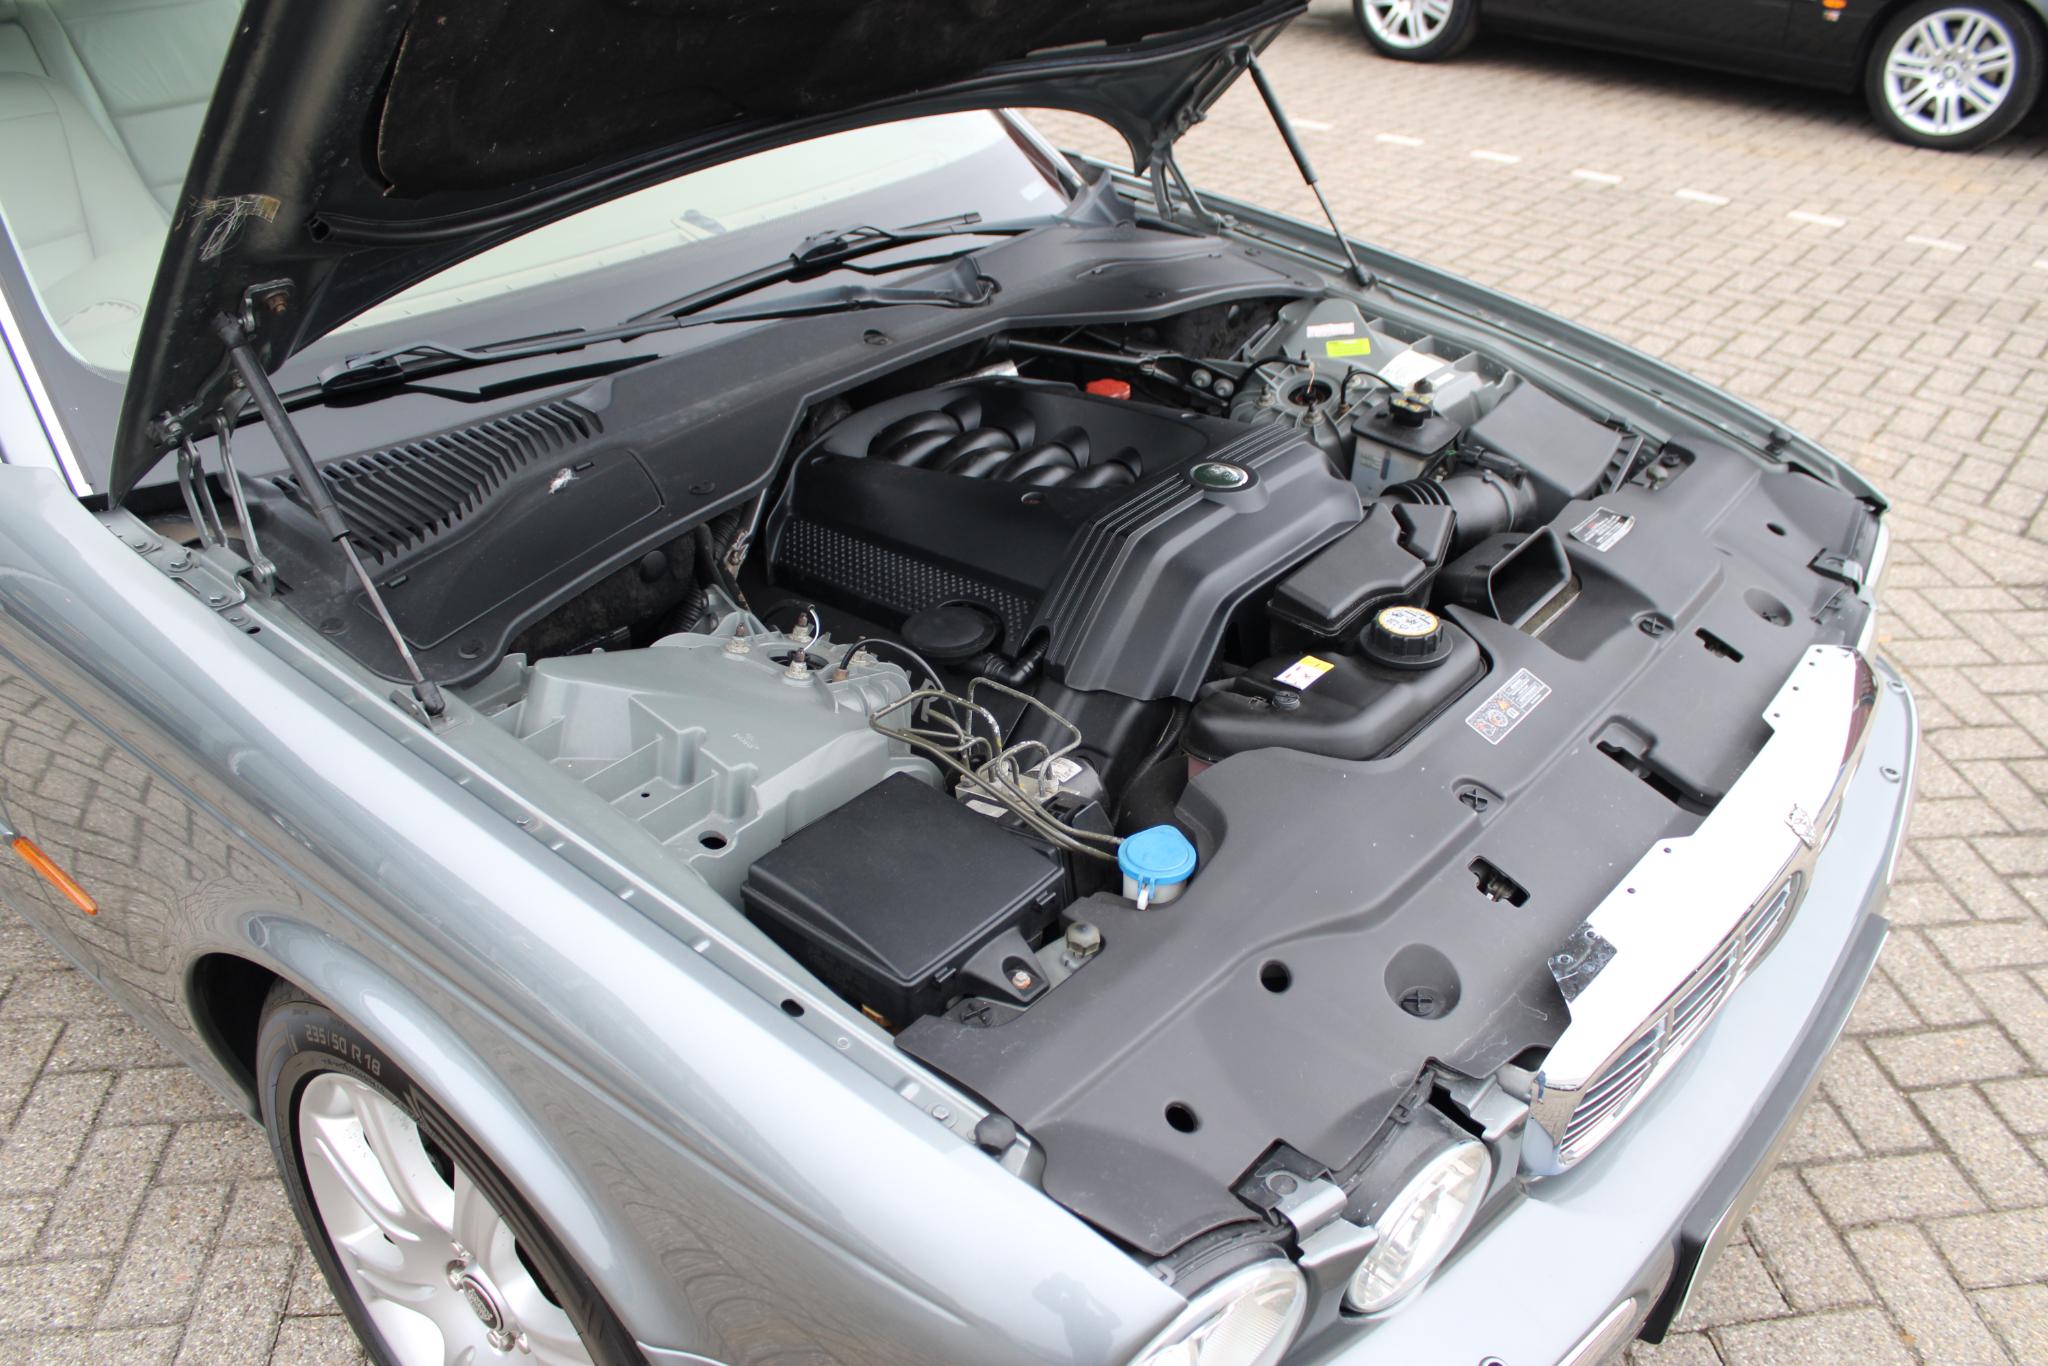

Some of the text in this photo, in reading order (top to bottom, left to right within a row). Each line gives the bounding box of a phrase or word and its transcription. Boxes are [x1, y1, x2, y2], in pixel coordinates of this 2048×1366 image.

[304, 1024, 381, 1077] 235/50 R 18
